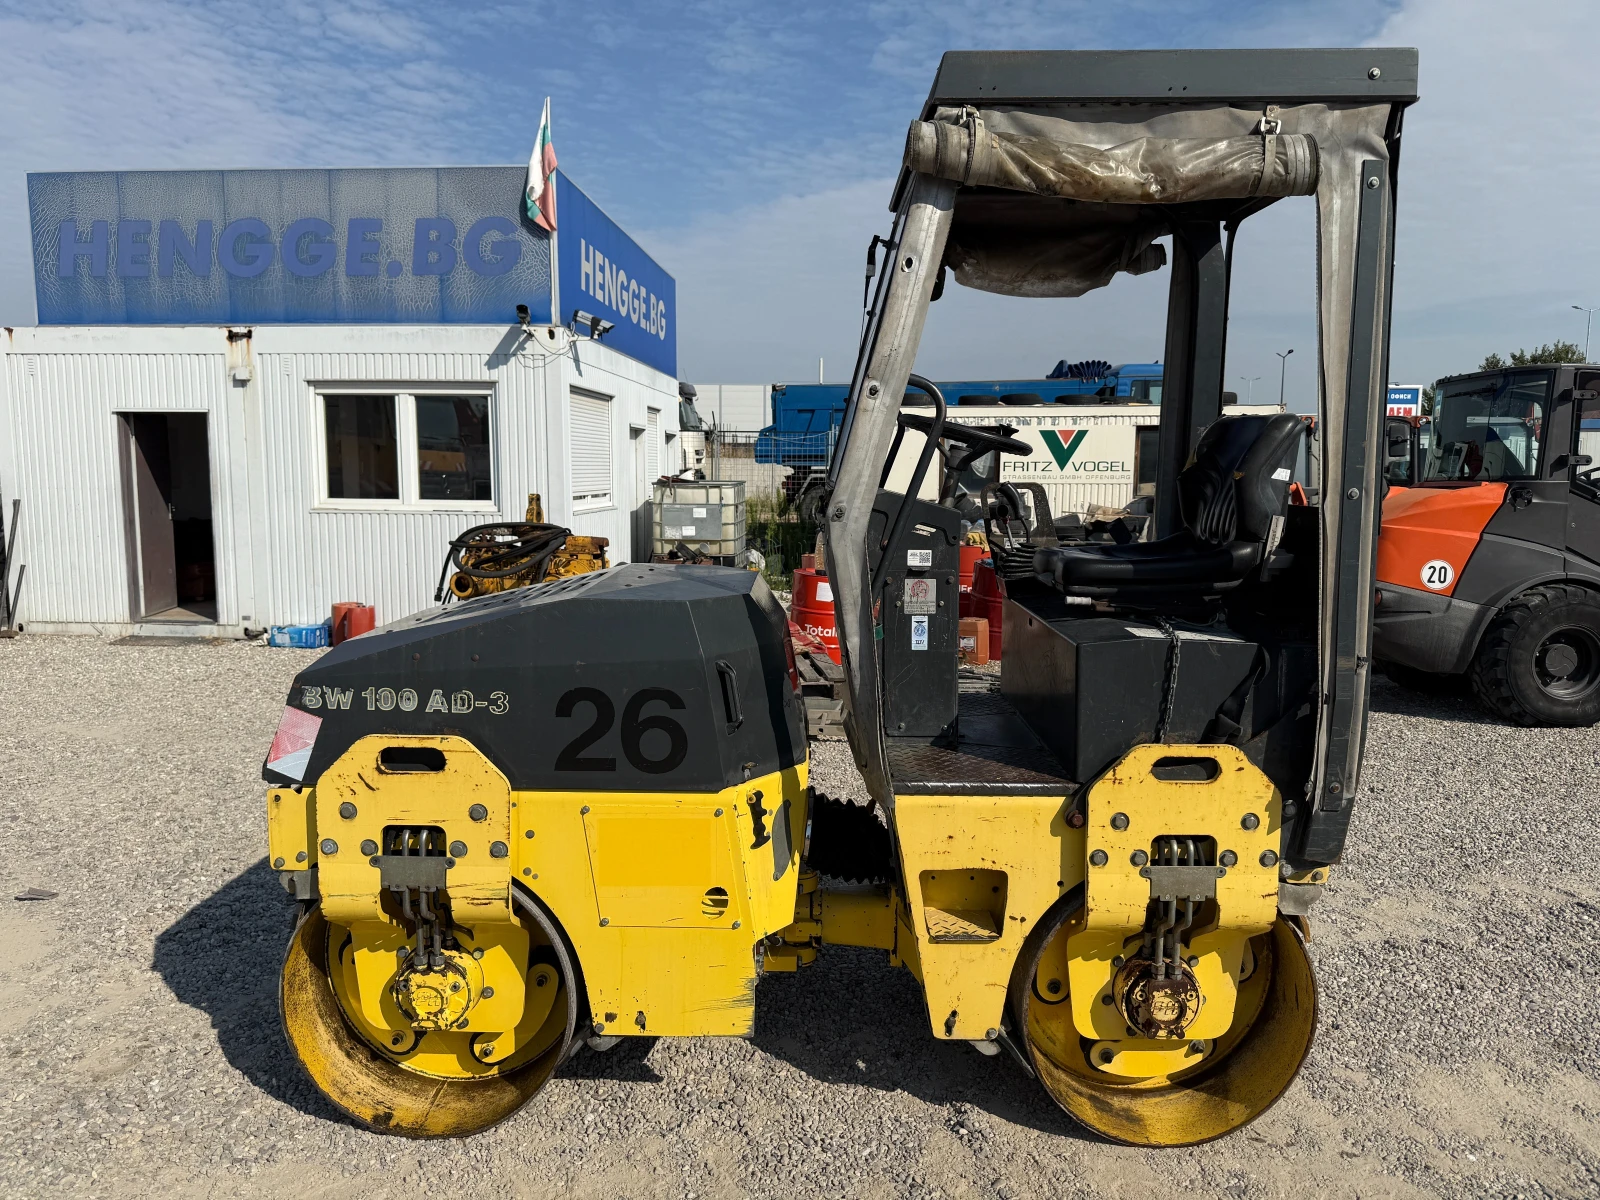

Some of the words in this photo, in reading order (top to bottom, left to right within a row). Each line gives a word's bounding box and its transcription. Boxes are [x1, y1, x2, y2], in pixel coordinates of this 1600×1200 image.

[58, 217, 522, 278] HENGGE.BG
[581, 238, 666, 341] HENGGE.BG
[1002, 461, 1053, 472] FRITZ
[1071, 461, 1131, 472] VOGEL
[1427, 565, 1448, 584] 20
[804, 623, 838, 638] Total
[301, 685, 355, 710] BW
[361, 686, 419, 712] 100
[425, 688, 509, 715] AD-3
[554, 686, 688, 775] 26
